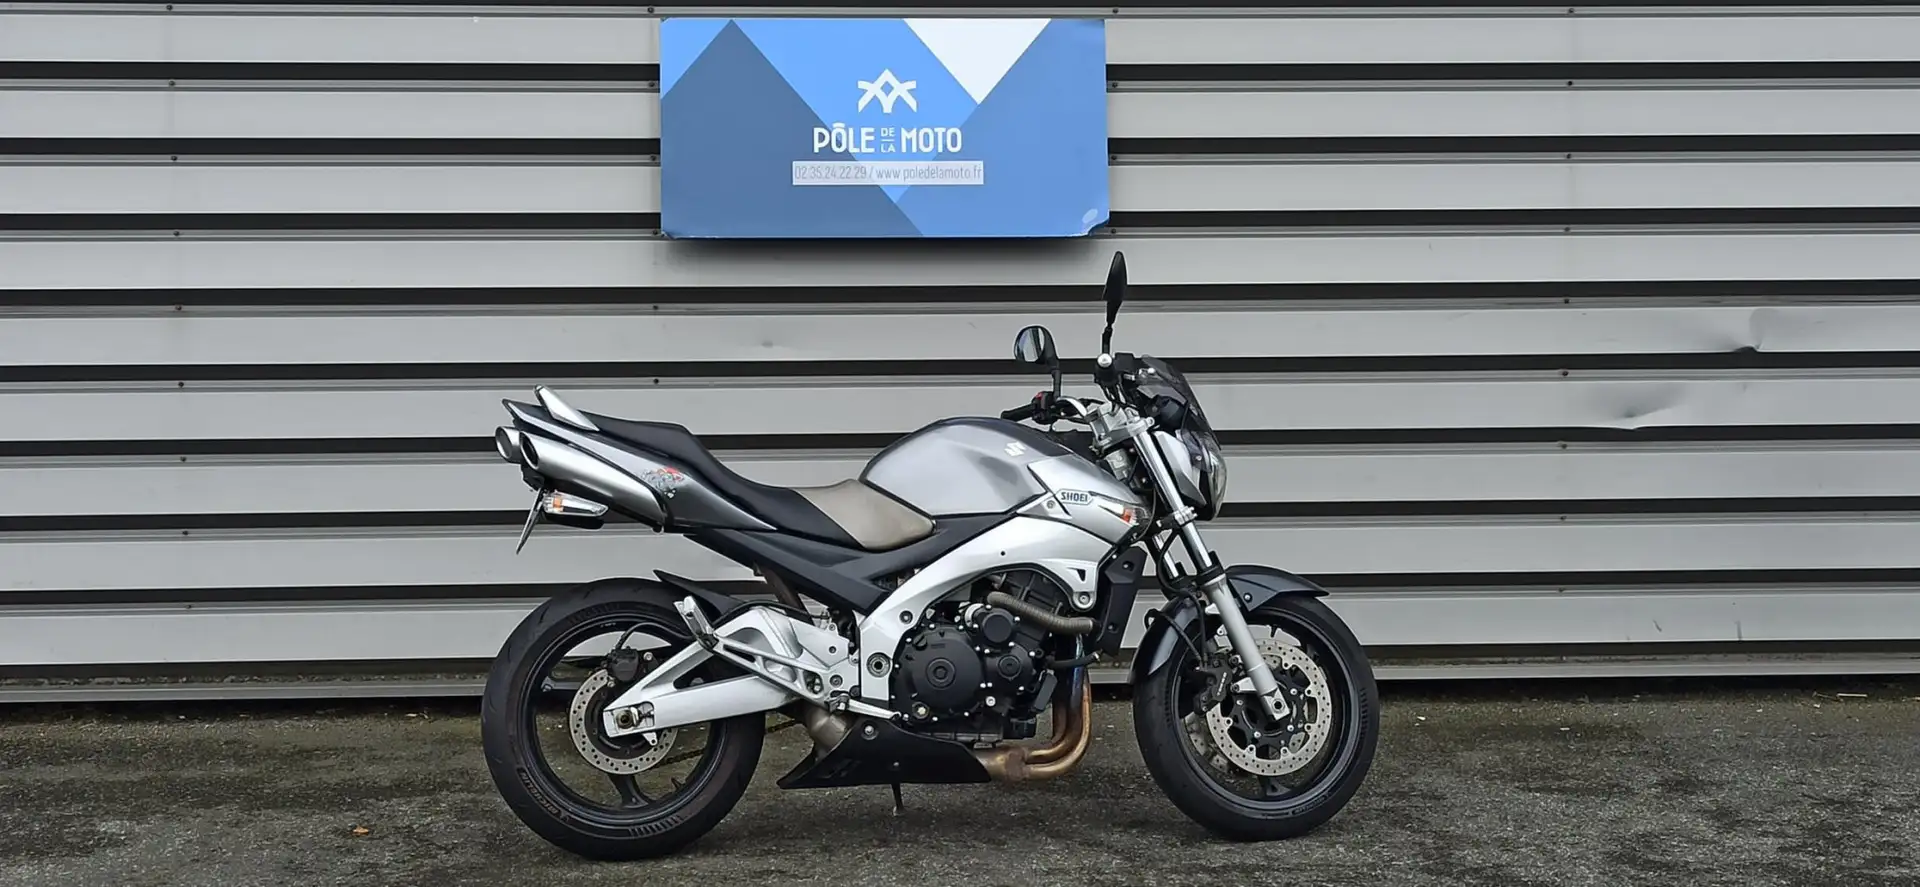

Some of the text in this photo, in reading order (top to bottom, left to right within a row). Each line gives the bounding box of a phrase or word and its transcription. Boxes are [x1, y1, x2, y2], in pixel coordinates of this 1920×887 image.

[813, 122, 962, 153] PÔLE DE MOTO
[880, 145, 896, 153] LA
[1060, 491, 1088, 502] SHOEI
